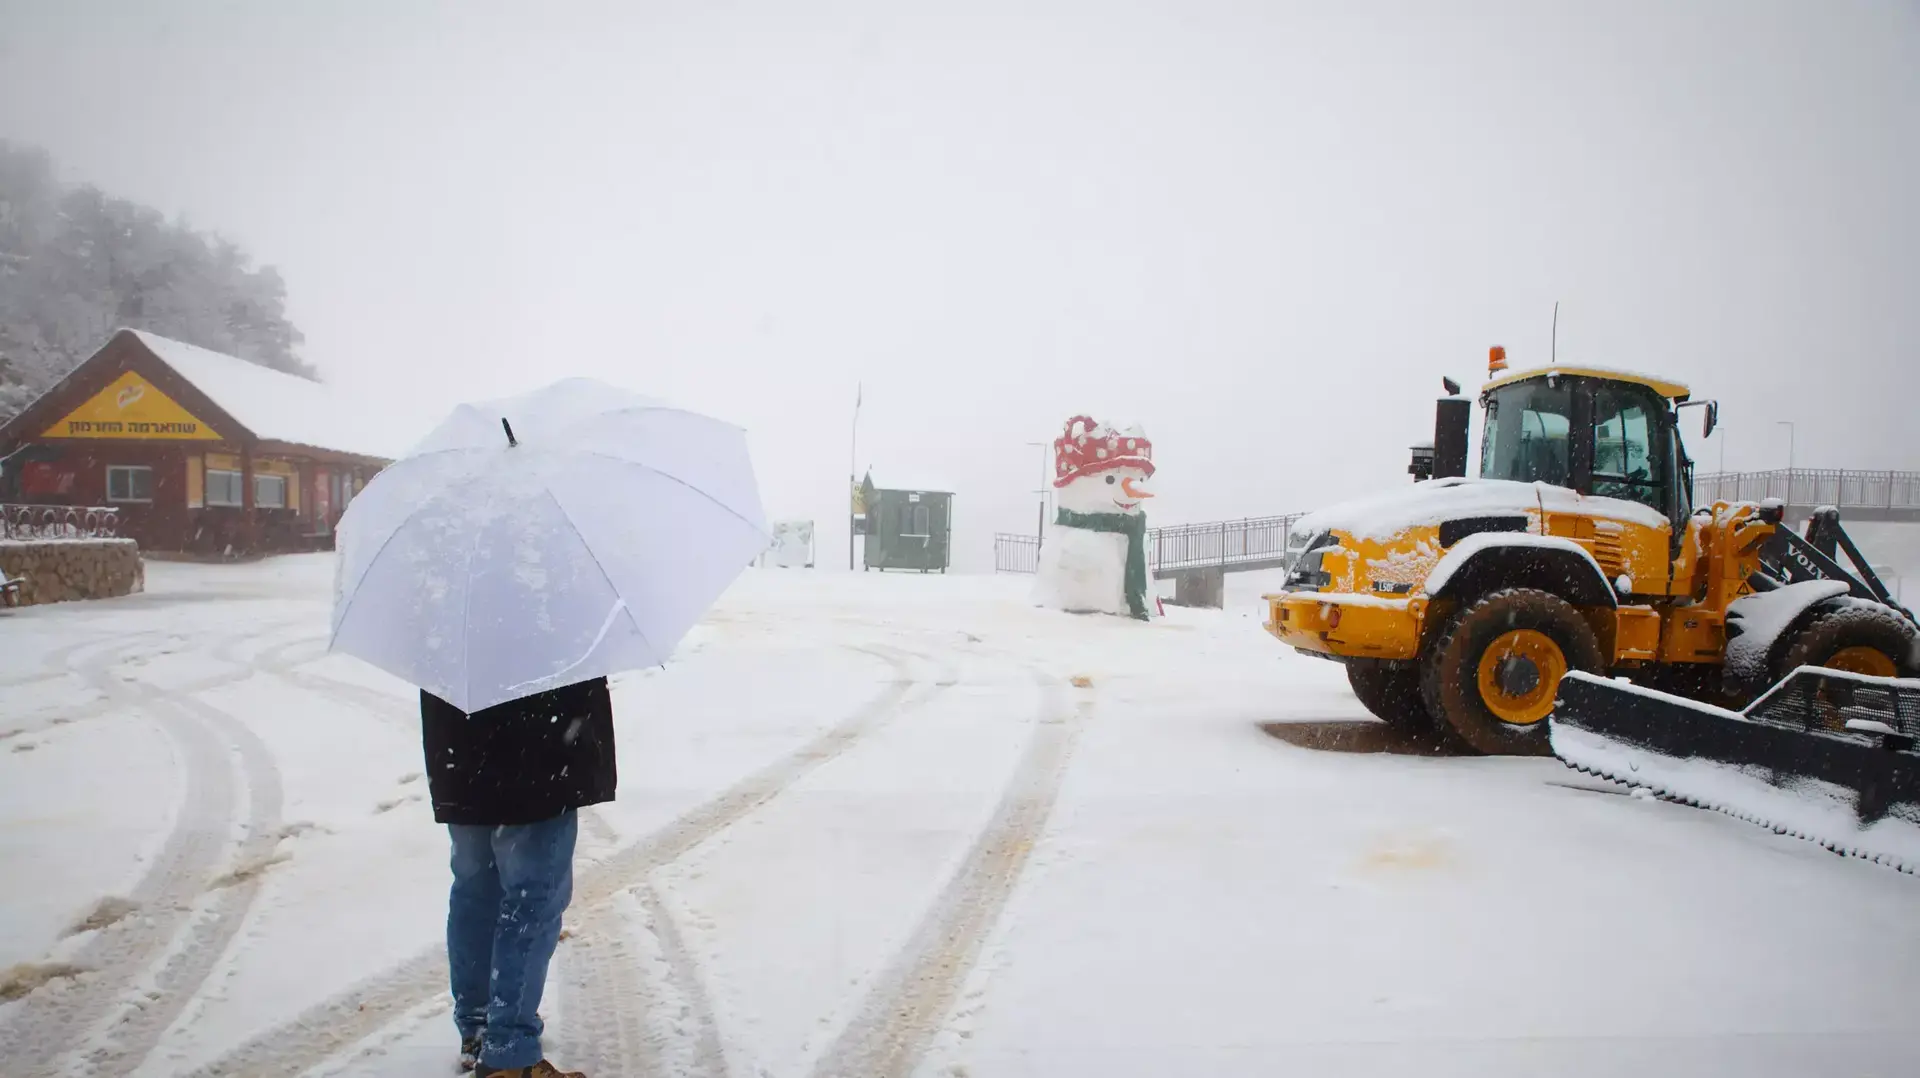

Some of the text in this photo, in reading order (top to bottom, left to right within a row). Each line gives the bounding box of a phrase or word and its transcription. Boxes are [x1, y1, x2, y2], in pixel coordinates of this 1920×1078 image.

[68, 420, 197, 434] שווארמה החרמון
[1788, 541, 1830, 580] VOLV
